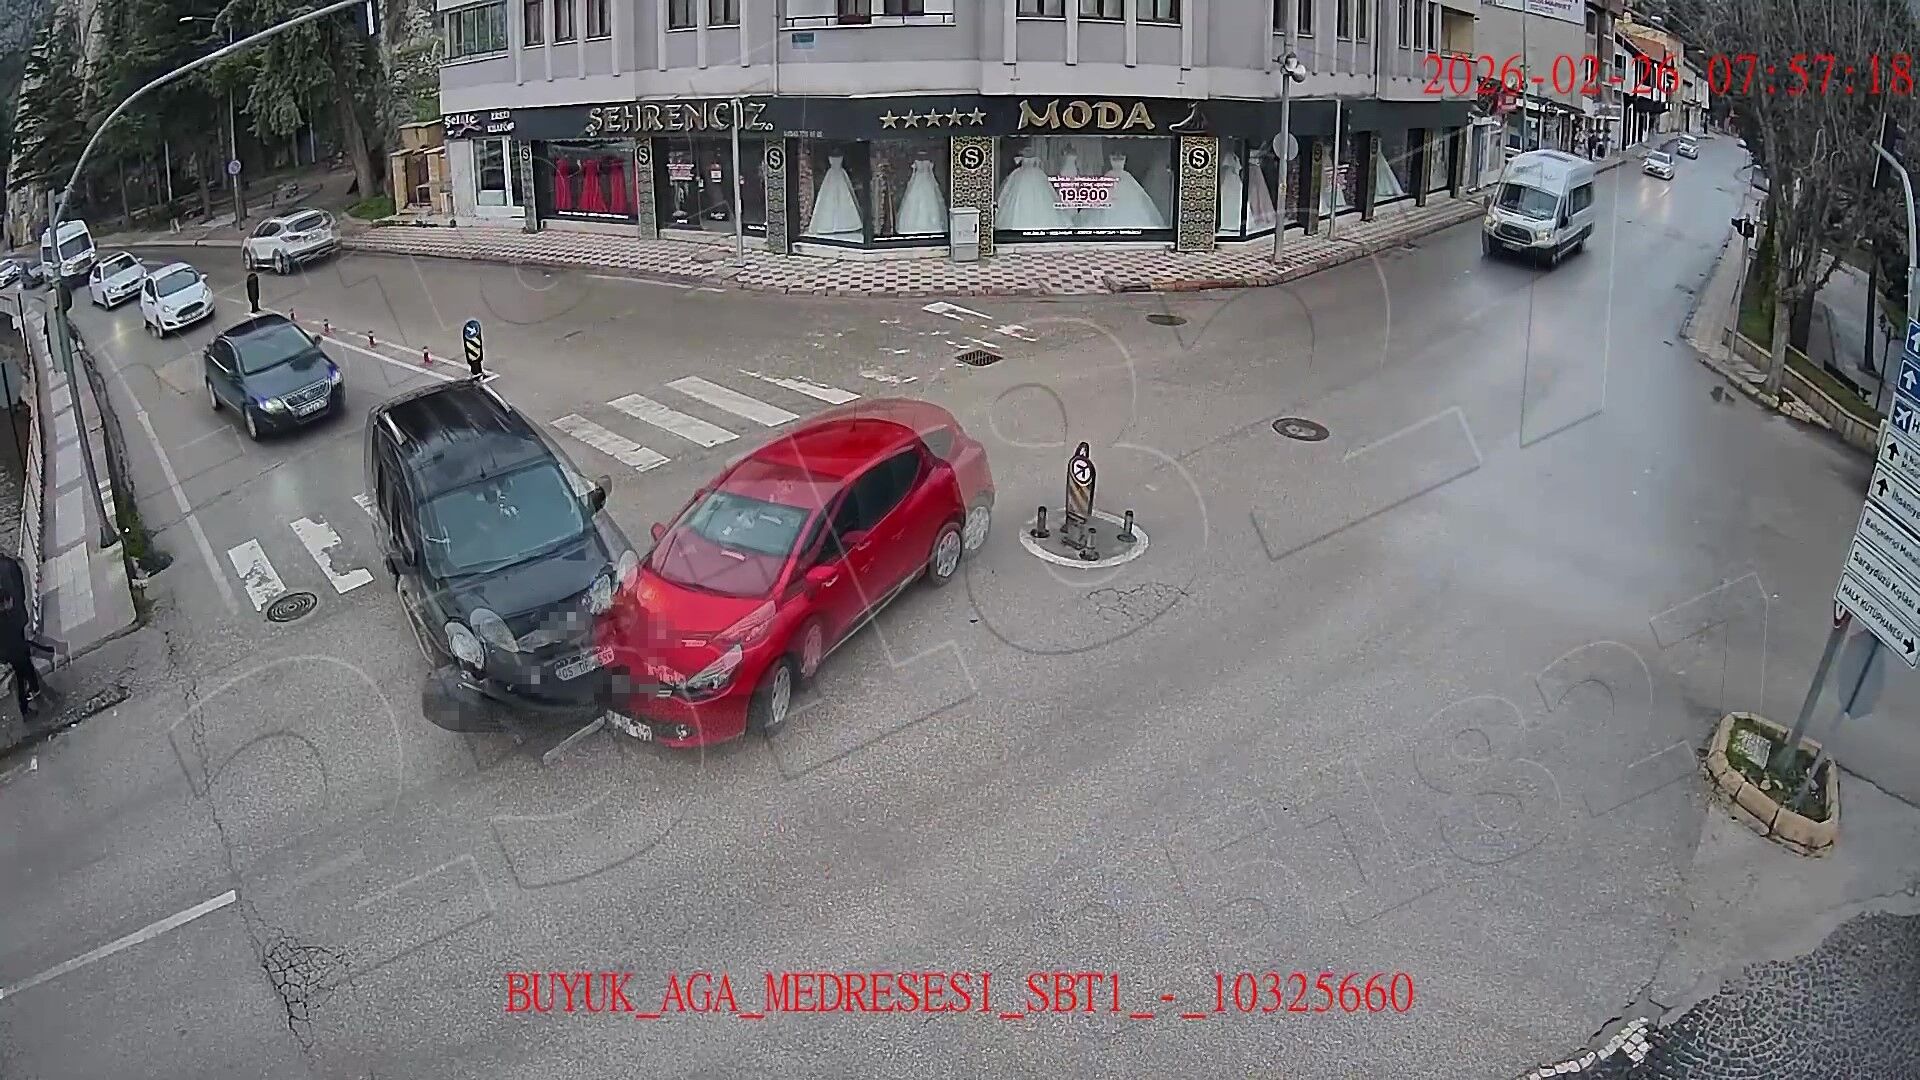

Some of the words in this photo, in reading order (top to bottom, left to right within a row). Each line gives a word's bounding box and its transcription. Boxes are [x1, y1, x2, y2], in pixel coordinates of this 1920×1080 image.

[1018, 100, 1156, 130] MODA
[1060, 189, 1108, 201] 19.900
[1842, 584, 1861, 605] HALK
